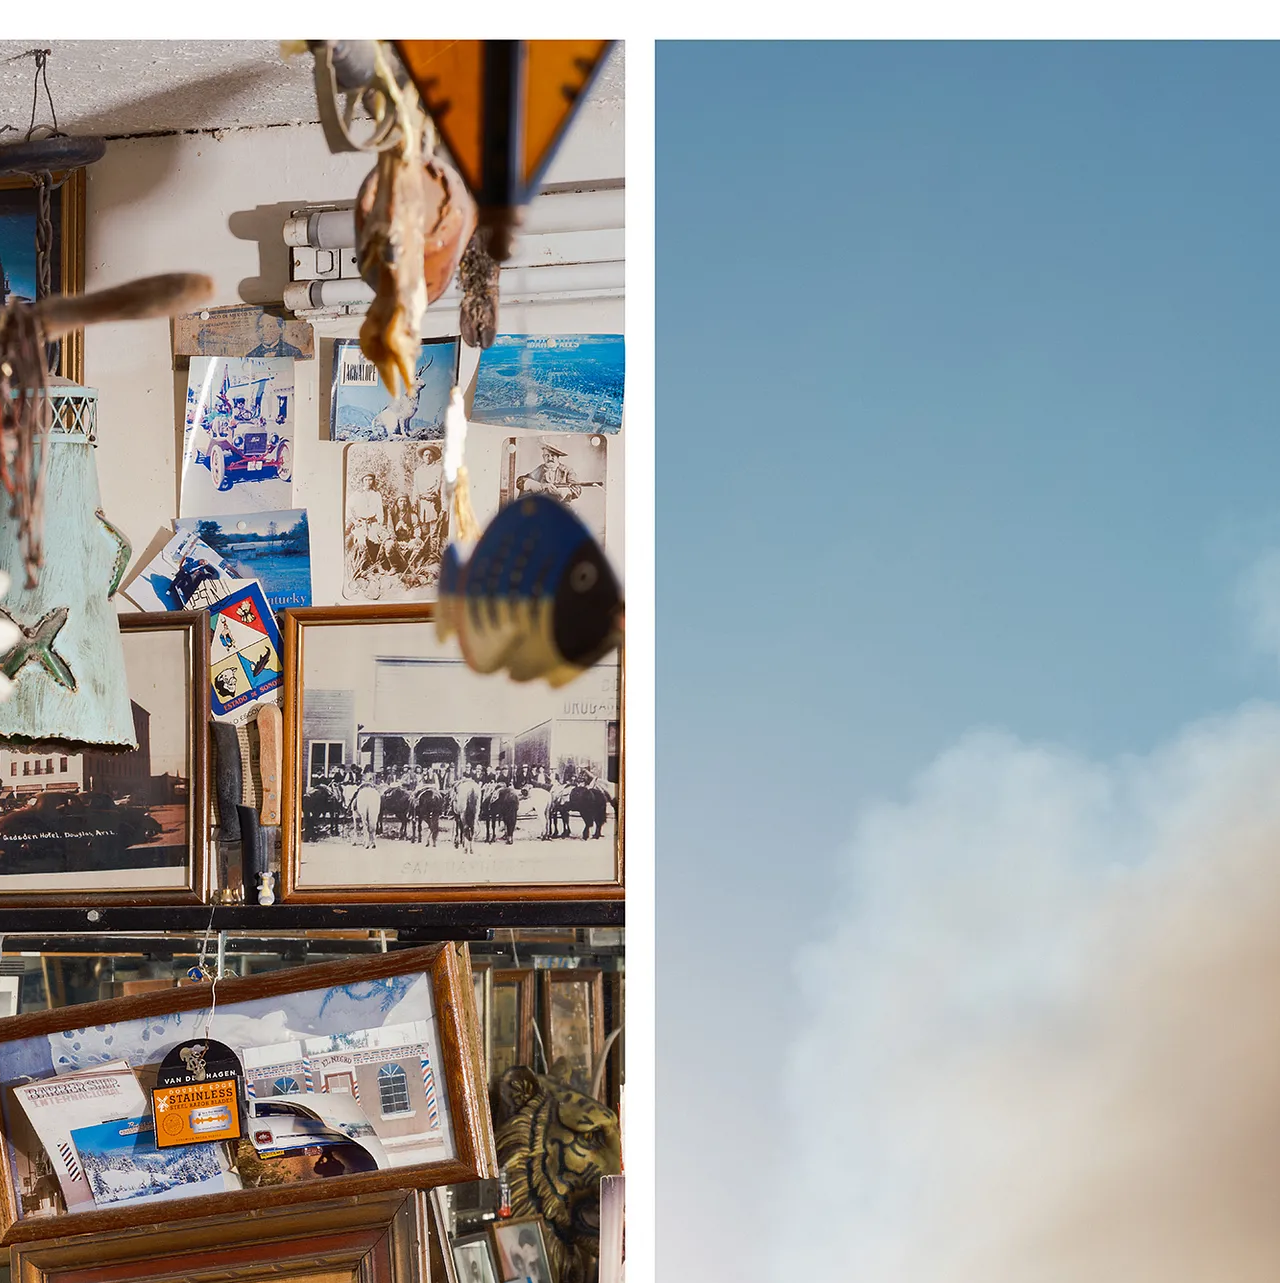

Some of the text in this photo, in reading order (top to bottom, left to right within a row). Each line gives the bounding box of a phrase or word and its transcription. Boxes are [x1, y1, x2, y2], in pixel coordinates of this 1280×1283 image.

[526, 338, 554, 349] IDAH
[267, 593, 307, 607] ntucky
[223, 695, 249, 711] ESTADO
[164, 1076, 182, 1085] VAN
[206, 1070, 236, 1079] HAGEN
[169, 1087, 233, 1105] STAINLESS
